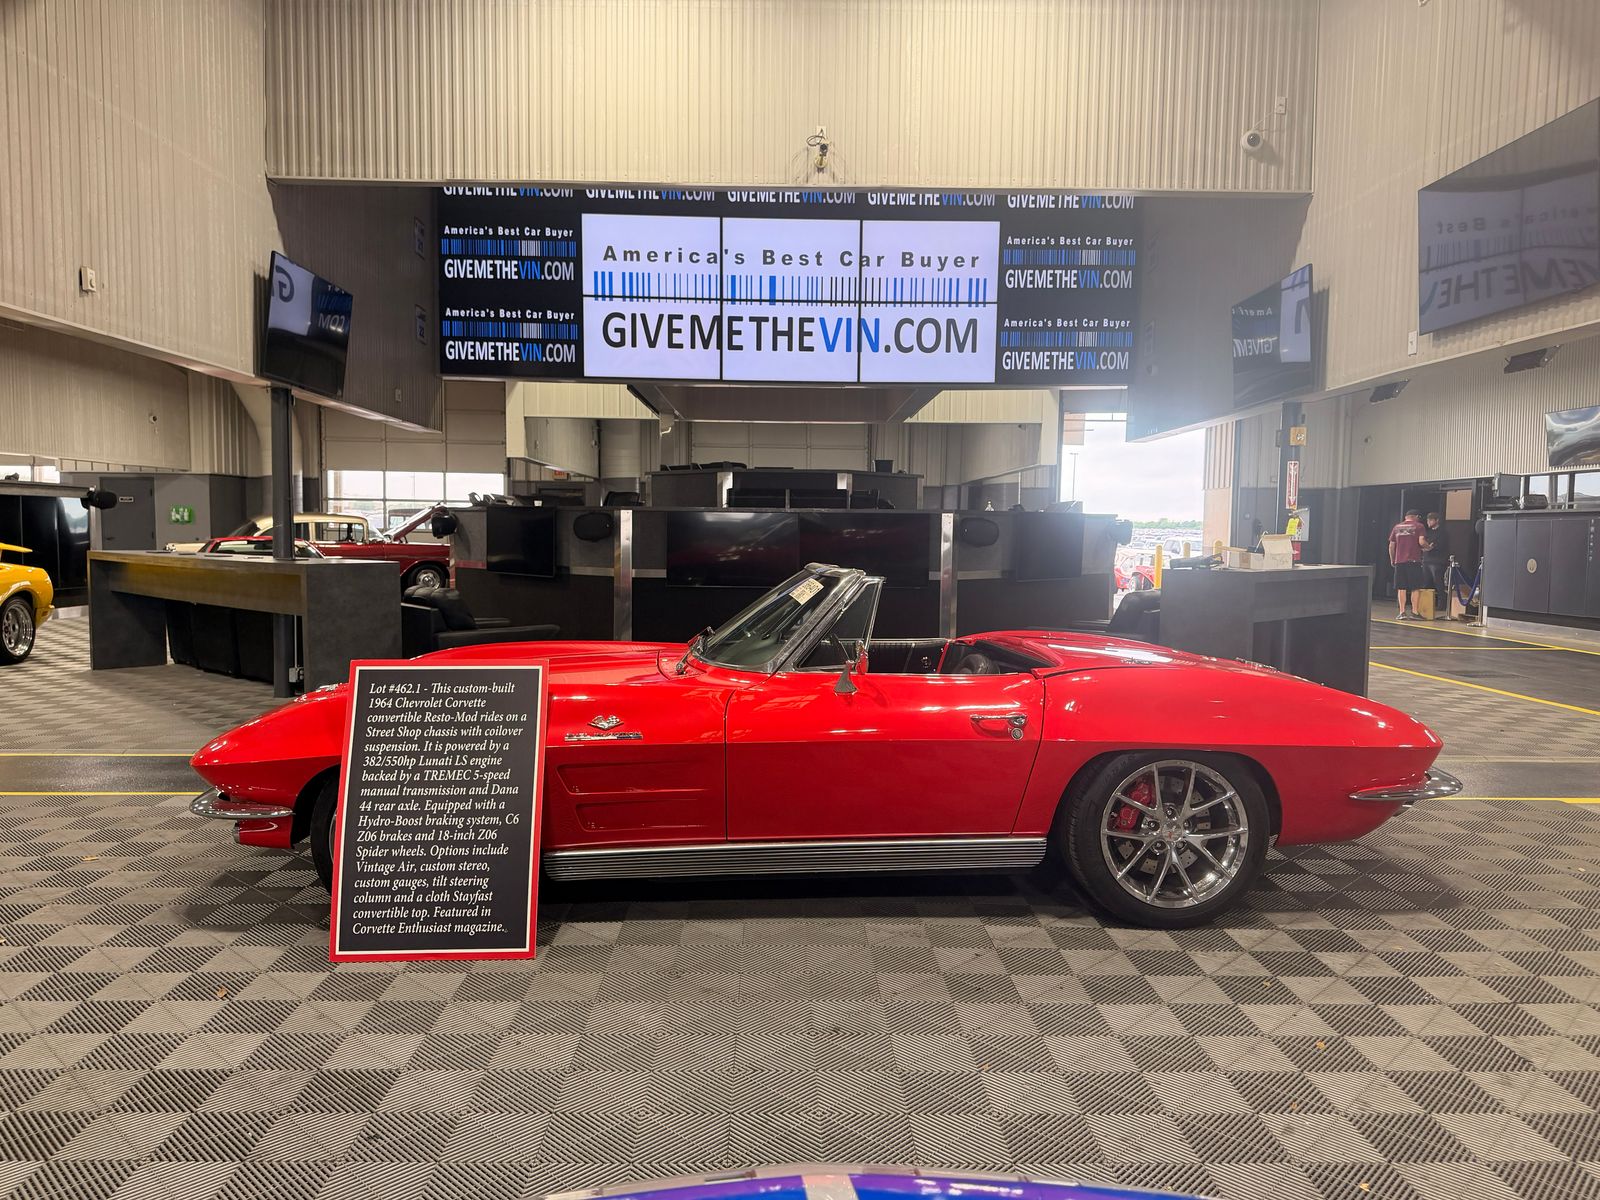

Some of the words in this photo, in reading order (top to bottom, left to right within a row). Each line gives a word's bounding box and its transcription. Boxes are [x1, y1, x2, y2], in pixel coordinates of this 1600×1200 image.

[444, 226, 493, 236] America's
[498, 226, 520, 236] Best
[524, 226, 541, 236] Car
[545, 227, 573, 238] Buyer
[1007, 236, 1055, 245] America's
[1060, 237, 1081, 245] Best
[1086, 237, 1102, 246] Car
[1106, 237, 1133, 247] Buyer
[602, 245, 746, 266] America's
[762, 249, 824, 266] Best
[840, 251, 886, 267] Car
[901, 252, 980, 272] Buyer
[444, 260, 574, 280] GIVEMETHEVIN.COM
[1005, 270, 1132, 289] GIVEMETHEVIN.COM
[445, 308, 495, 318] America's
[499, 309, 521, 318] Best
[526, 309, 542, 319] Car
[546, 310, 575, 321] Buyer
[1004, 318, 1052, 328] America's
[1057, 318, 1078, 328] Best
[1082, 319, 1098, 328] Car
[1103, 319, 1130, 330] Buyer
[602, 312, 978, 354] GIVEMETHEVIN.COM
[446, 341, 575, 363] GIVEMETHEVIN.COM
[1002, 352, 1129, 370] GIVEMETHEVIN.COM
[369, 683, 387, 694] Lot
[388, 683, 421, 693] #462.1
[432, 682, 451, 694] This
[454, 682, 515, 693] custom-built
[368, 698, 392, 708] 1964
[395, 697, 442, 708] Chevrolet
[445, 697, 487, 708] Corvette
[367, 712, 422, 723] convertible
[424, 712, 478, 722] Resto-Mod
[480, 712, 503, 722] rides
[366, 727, 395, 737] Street
[397, 727, 421, 740] Shop
[424, 726, 458, 736] chassis
[461, 725, 482, 736] with
[485, 725, 523, 736] coilover
[364, 741, 421, 753] suspension.
[424, 741, 433, 751] It
[435, 741, 443, 751] is
[445, 740, 487, 754] powered
[489, 740, 500, 753] by
[503, 743, 509, 751] a
[363, 756, 416, 769] 382/550hp
[418, 755, 453, 766] Lunati
[455, 755, 468, 765] LS
[470, 755, 502, 769] engine
[362, 770, 397, 781] backed
[400, 770, 412, 784] by
[424, 770, 472, 780] TREMEC
[473, 769, 511, 783] 5-speed
[361, 785, 401, 796] manual
[403, 785, 465, 795] transmission
[469, 784, 488, 795] and
[491, 784, 519, 794] Dana
[359, 801, 372, 812] 44
[374, 803, 395, 811] rear
[398, 800, 421, 811] axle.
[424, 799, 472, 814] Equipped
[475, 798, 496, 810] with
[358, 815, 423, 829] Hydro-Boost
[425, 814, 463, 828] braking
[466, 815, 502, 828] system,
[505, 814, 519, 824] C6
[357, 831, 377, 842] Z06
[380, 830, 412, 841] brakes
[415, 830, 435, 841] and
[438, 830, 475, 840] 18-inch
[477, 829, 497, 840] Z06
[356, 846, 389, 860] Spider
[392, 846, 427, 857] wheels.
[430, 845, 470, 859] Options
[472, 844, 508, 855] include
[356, 862, 395, 875] Vintage
[398, 862, 417, 873] Air,
[420, 863, 456, 871] custom
[458, 863, 490, 872] stereo,
[354, 879, 390, 888] custom
[393, 879, 429, 890] gauges,
[433, 877, 448, 887] tilt
[450, 876, 489, 889] steering
[354, 893, 391, 903] column
[394, 892, 414, 903] and
[425, 891, 450, 902] cloth
[453, 891, 493, 904] Stayfast
[353, 907, 409, 919] convertible
[411, 909, 430, 920] top.
[433, 907, 478, 917] Featured
[481, 907, 491, 917] in
[352, 923, 395, 934] Corvette
[398, 922, 451, 934] Enthusiast
[454, 923, 505, 935] magazine.
